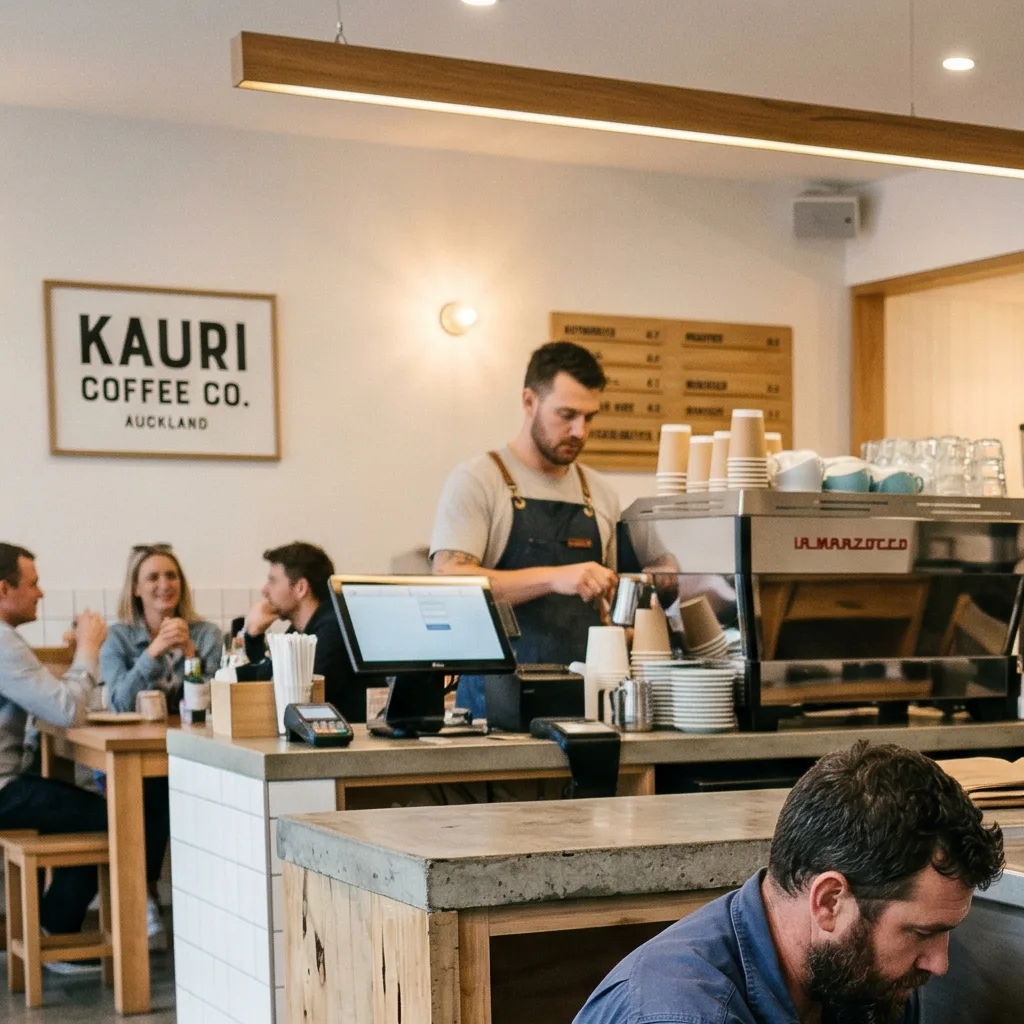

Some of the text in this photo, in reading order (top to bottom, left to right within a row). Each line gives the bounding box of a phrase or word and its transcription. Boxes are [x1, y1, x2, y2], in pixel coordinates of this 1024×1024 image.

[79, 314, 247, 371] KAURI
[81, 376, 249, 408] COFFEE CO.
[125, 415, 208, 430] AUCKLAND
[816, 537, 907, 550] MARZOCCO
